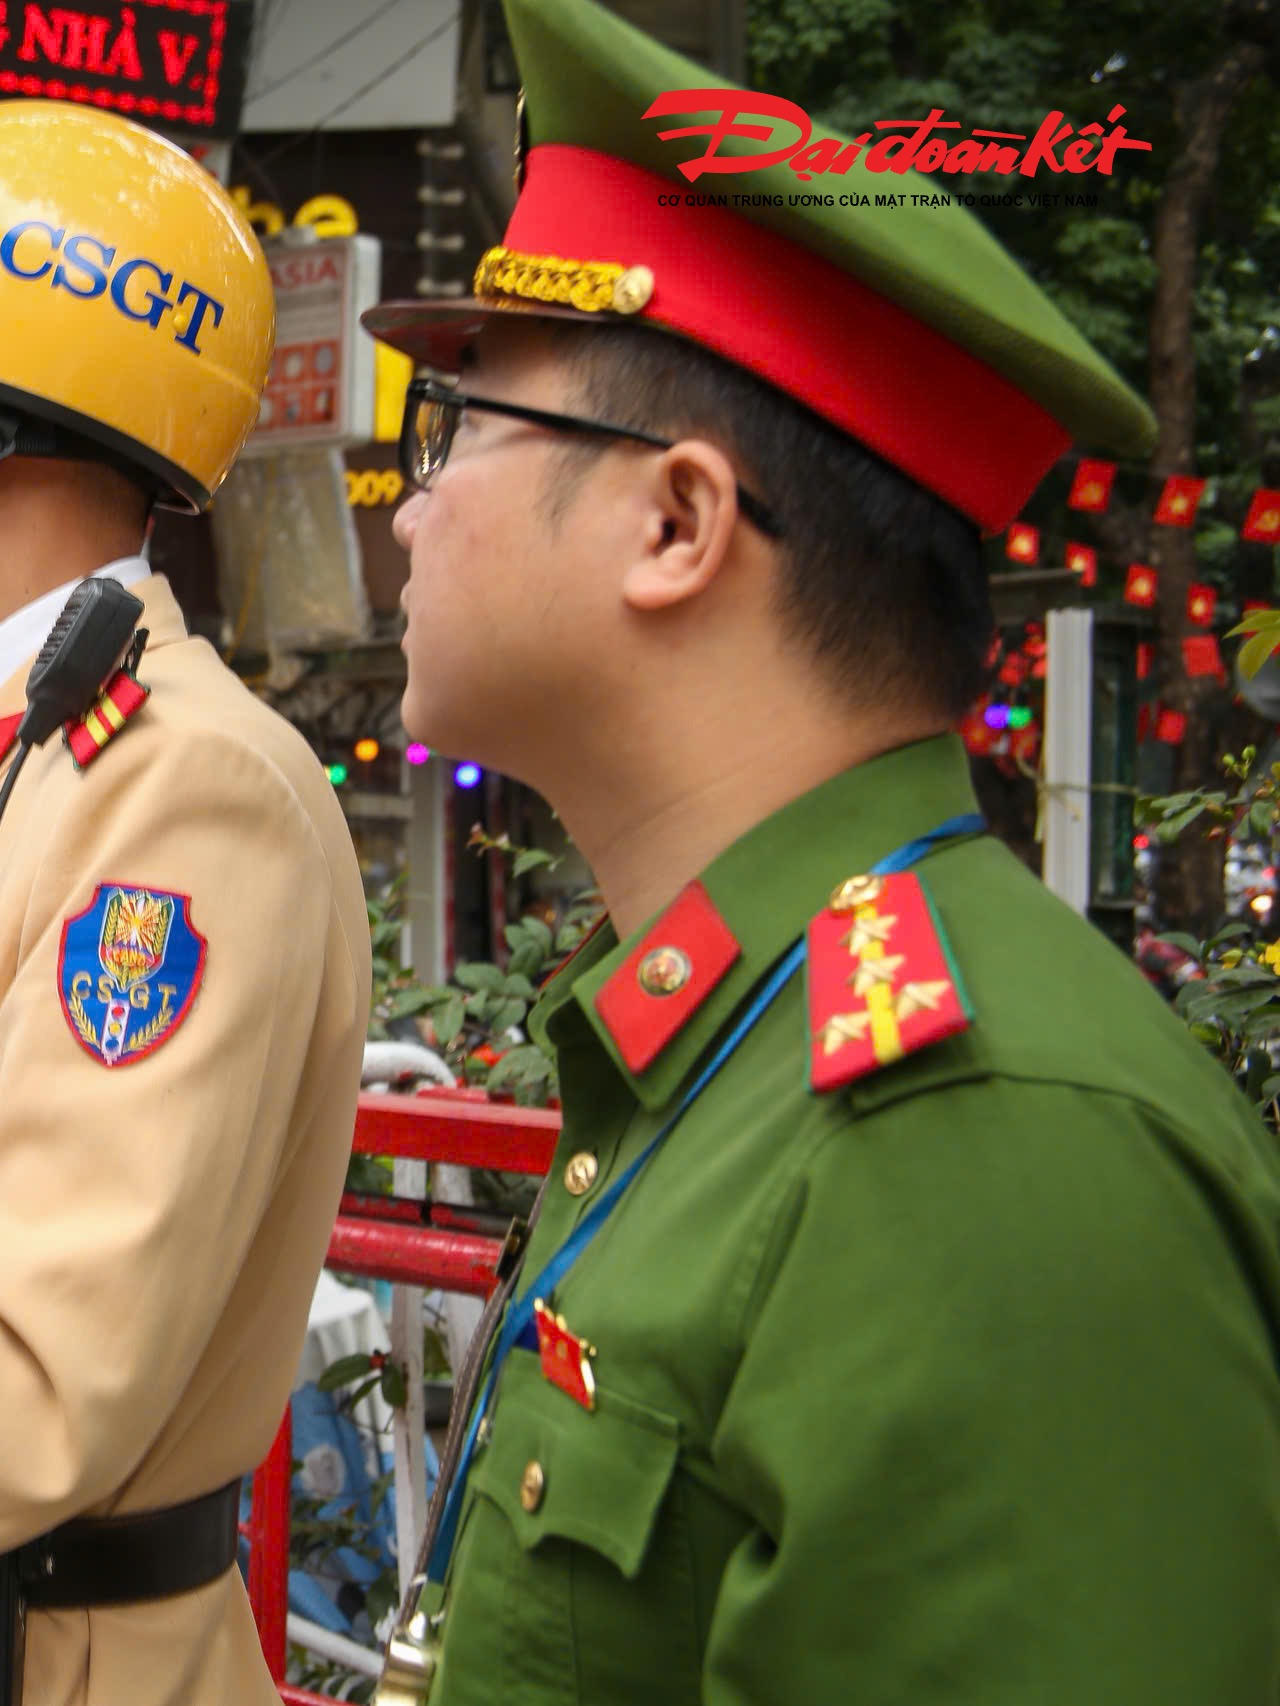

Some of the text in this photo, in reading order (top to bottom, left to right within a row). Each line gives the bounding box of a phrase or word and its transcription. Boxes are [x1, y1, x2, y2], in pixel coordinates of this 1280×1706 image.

[17, 4, 143, 80] NHÀ
[0, 220, 225, 355] CSGT
[72, 970, 177, 1010] CSGT
